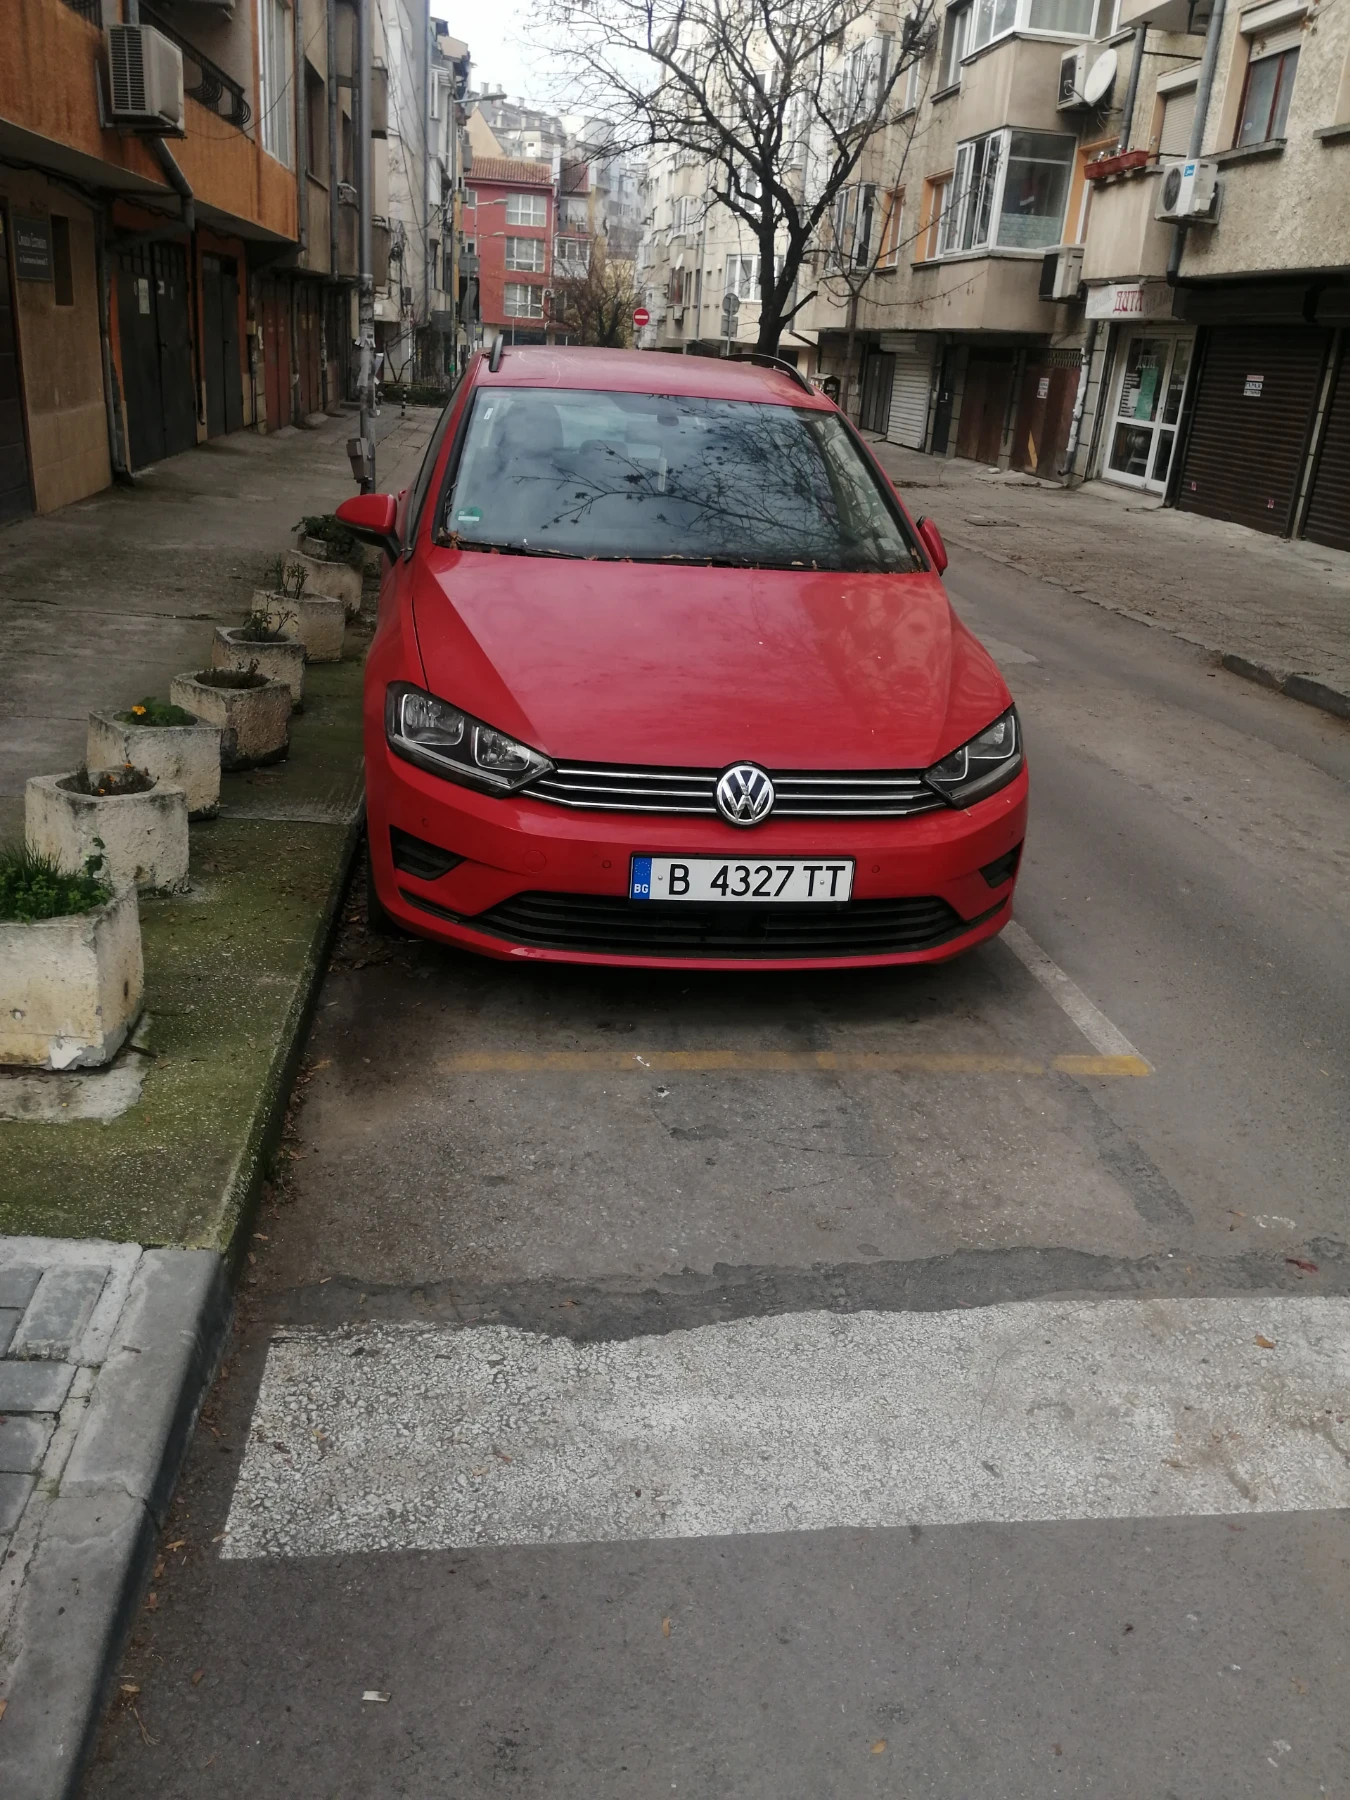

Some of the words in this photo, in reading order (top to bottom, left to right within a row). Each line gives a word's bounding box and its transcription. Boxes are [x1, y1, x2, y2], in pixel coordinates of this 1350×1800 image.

[633, 883, 649, 894] BG
[668, 863, 690, 895] B
[710, 865, 795, 897] 4327
[803, 866, 846, 897] TT
